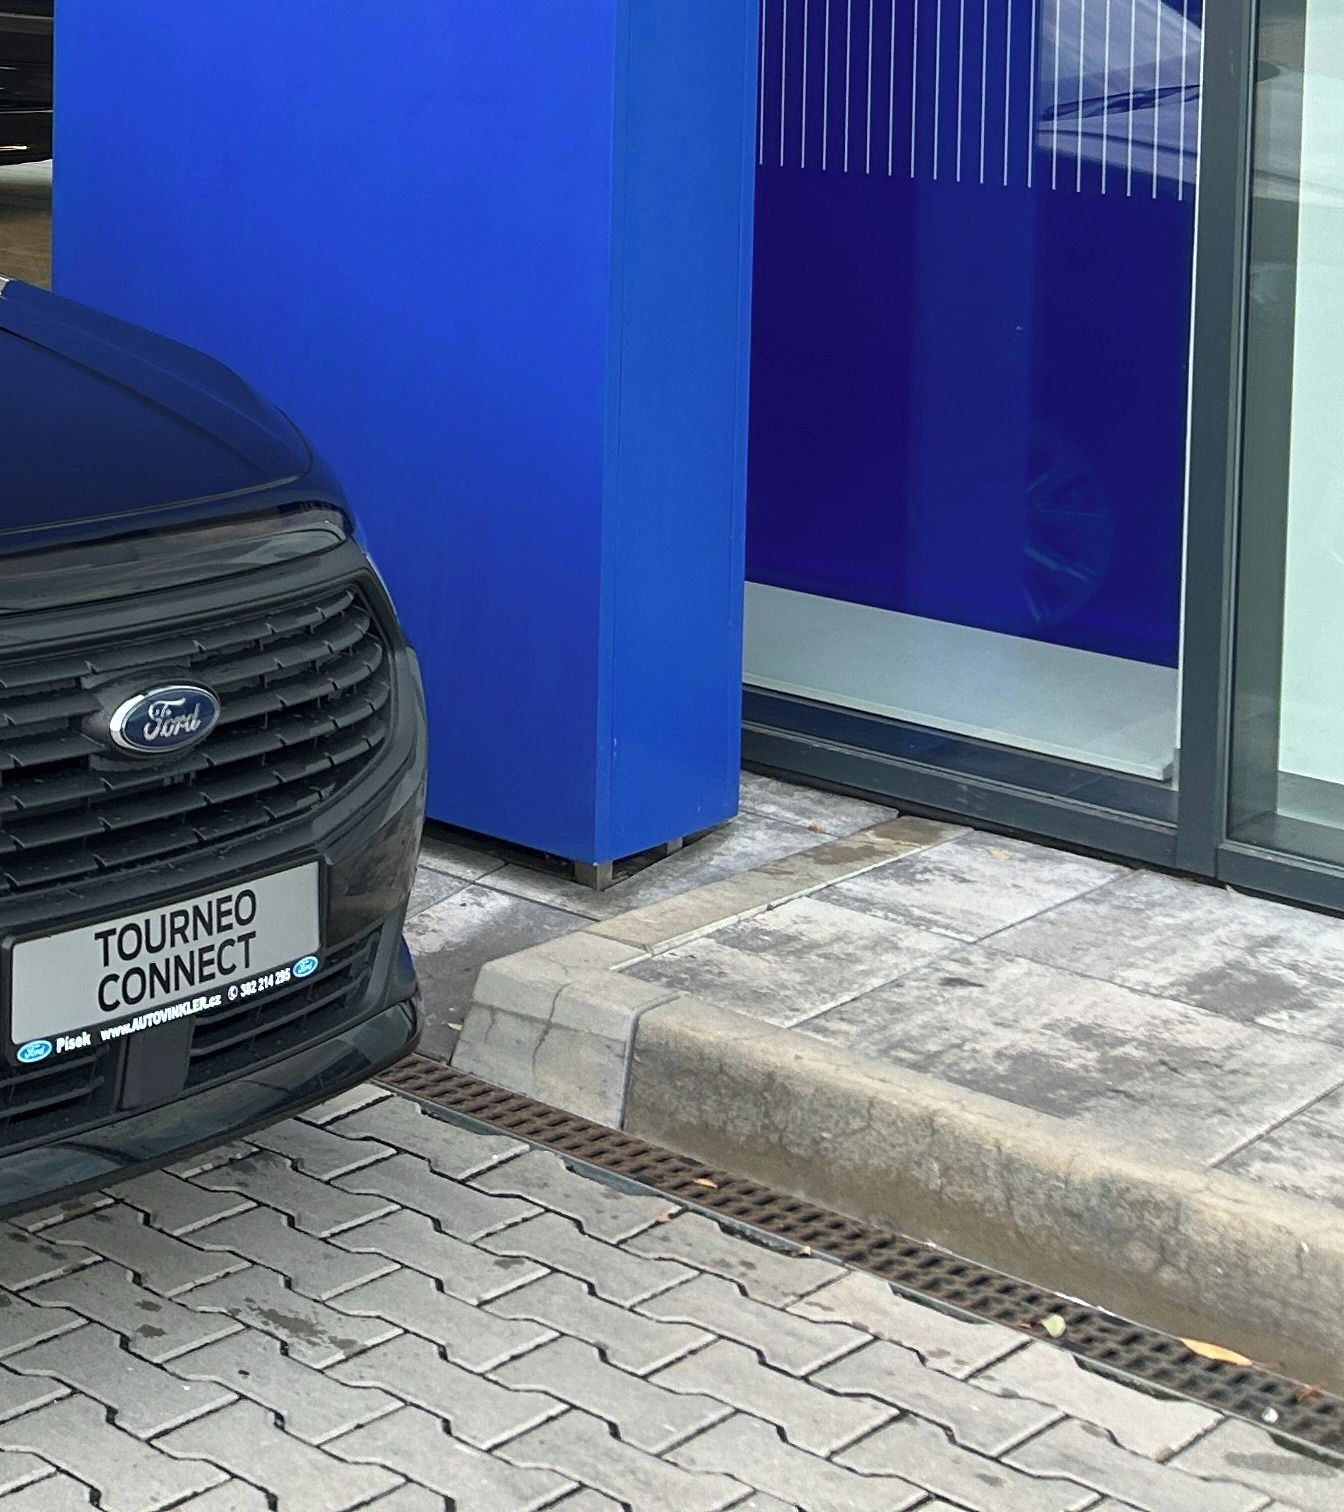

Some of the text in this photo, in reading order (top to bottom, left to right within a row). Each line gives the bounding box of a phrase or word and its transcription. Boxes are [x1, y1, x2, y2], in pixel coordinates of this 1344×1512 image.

[143, 697, 202, 741] Ford
[94, 889, 257, 968] TOURNEO
[98, 930, 257, 1013] CONNECT
